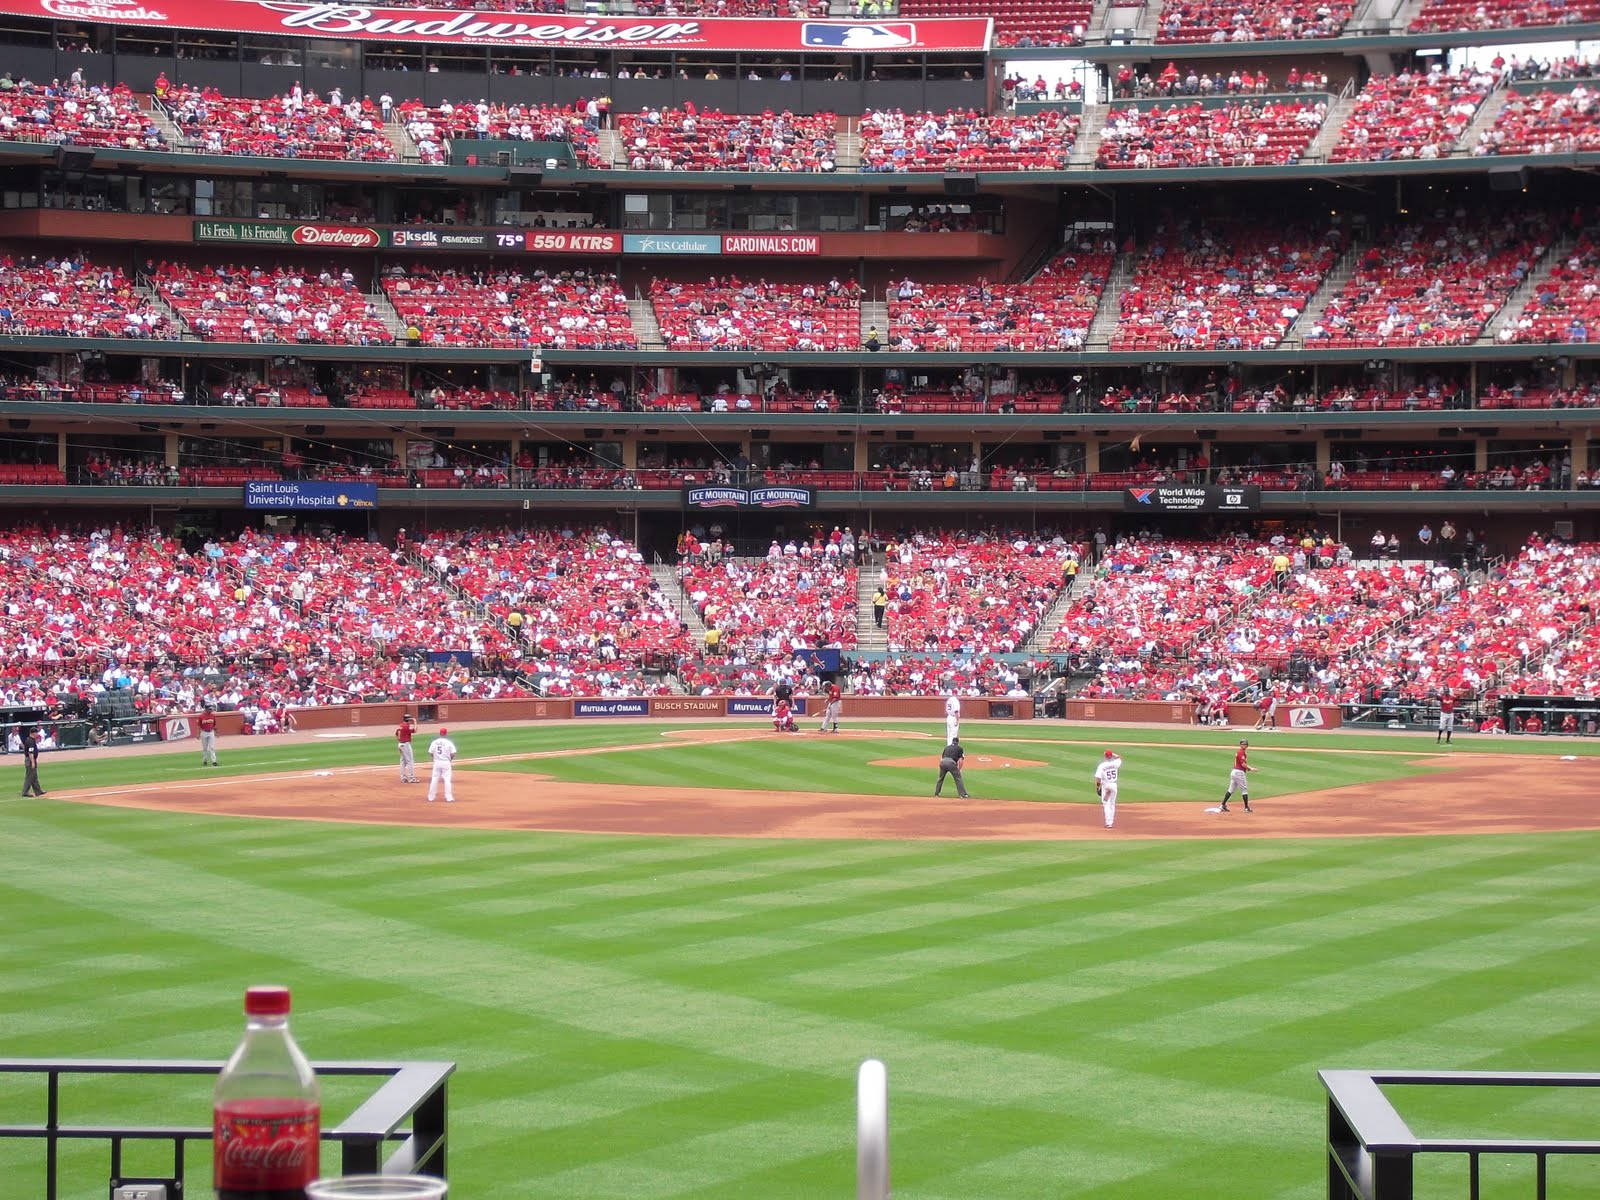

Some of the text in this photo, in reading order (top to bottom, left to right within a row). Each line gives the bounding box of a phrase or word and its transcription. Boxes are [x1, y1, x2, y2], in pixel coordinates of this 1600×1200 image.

[258, 2, 699, 42] Budweiser
[650, 37, 707, 45] BASEBALL
[200, 223, 237, 237] It's Fresh.
[241, 226, 288, 243] It's Friendly.
[302, 227, 371, 246] Dierbergs
[407, 231, 438, 241] ksdk
[496, 235, 524, 247] 75°
[533, 236, 613, 250] 550 KTRS
[672, 240, 706, 251] Cellular
[726, 237, 816, 252] CARDINALS.COM
[249, 483, 299, 494] Saint Louis
[249, 495, 335, 507] University Hospital
[692, 491, 745, 501] ICE MOUNTAIN
[766, 491, 807, 501] MOUNTAIN
[1159, 497, 1205, 506] Technology
[580, 704, 642, 713] MUTUAL of OMAHA
[654, 702, 719, 711] BUSCH STADIUM
[733, 703, 762, 711] MUTUAL
[763, 704, 772, 712] of
[437, 746, 443, 754] 5
[1106, 770, 1117, 780] 55
[224, 1137, 309, 1168] Coca-Cola
